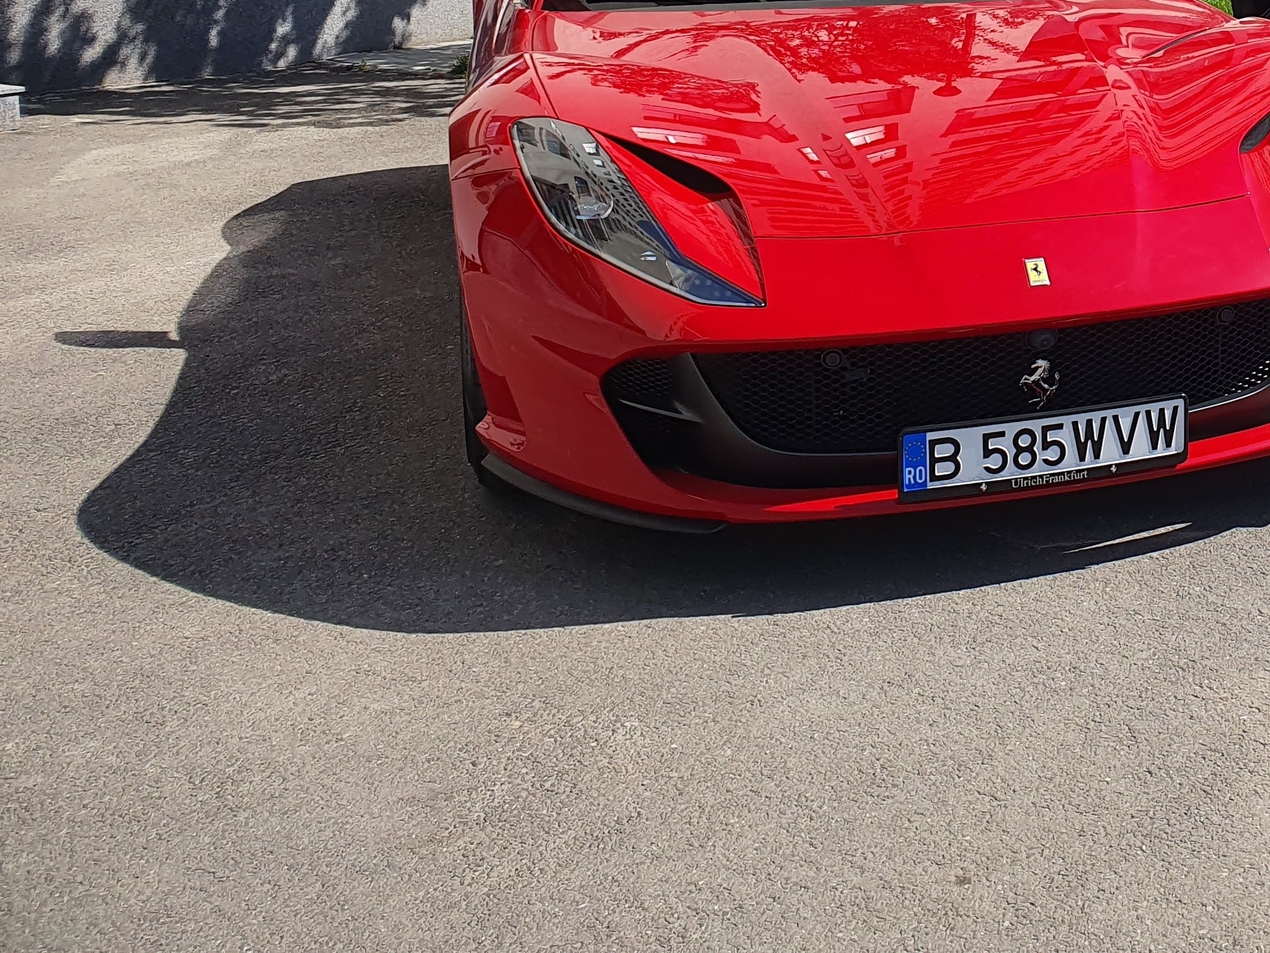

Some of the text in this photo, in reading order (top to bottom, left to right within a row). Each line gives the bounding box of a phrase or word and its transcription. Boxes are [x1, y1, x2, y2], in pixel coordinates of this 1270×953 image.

[928, 436, 962, 482] B
[905, 466, 925, 484] RO
[1011, 469, 1088, 489] UlrichFrankfurt
